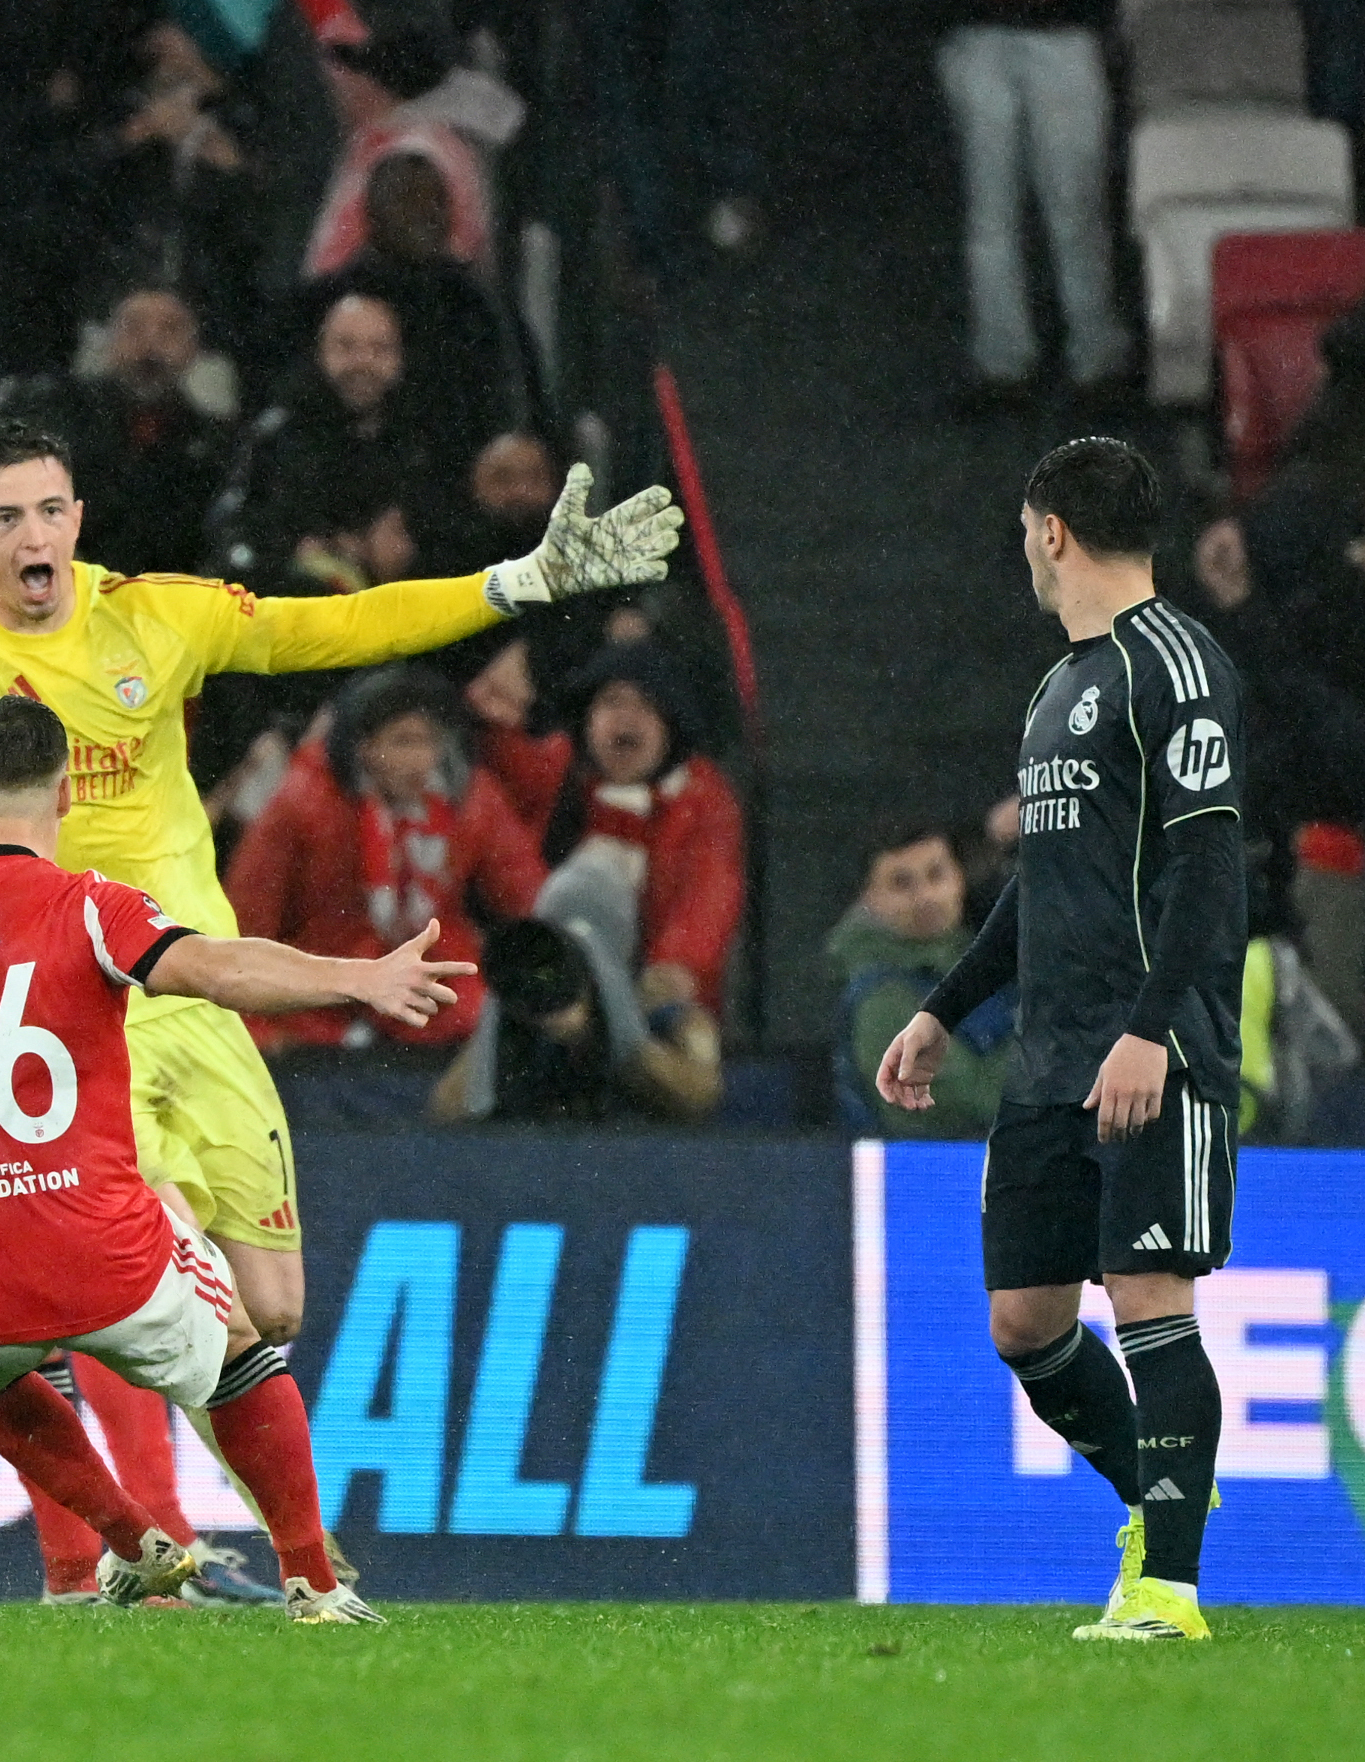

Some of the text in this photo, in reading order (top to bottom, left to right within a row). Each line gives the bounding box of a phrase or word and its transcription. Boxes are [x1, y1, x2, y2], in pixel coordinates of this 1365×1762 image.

[1176, 718, 1230, 791] hp
[1024, 796, 1081, 835] BETTER
[1137, 1436, 1195, 1450] MCF
